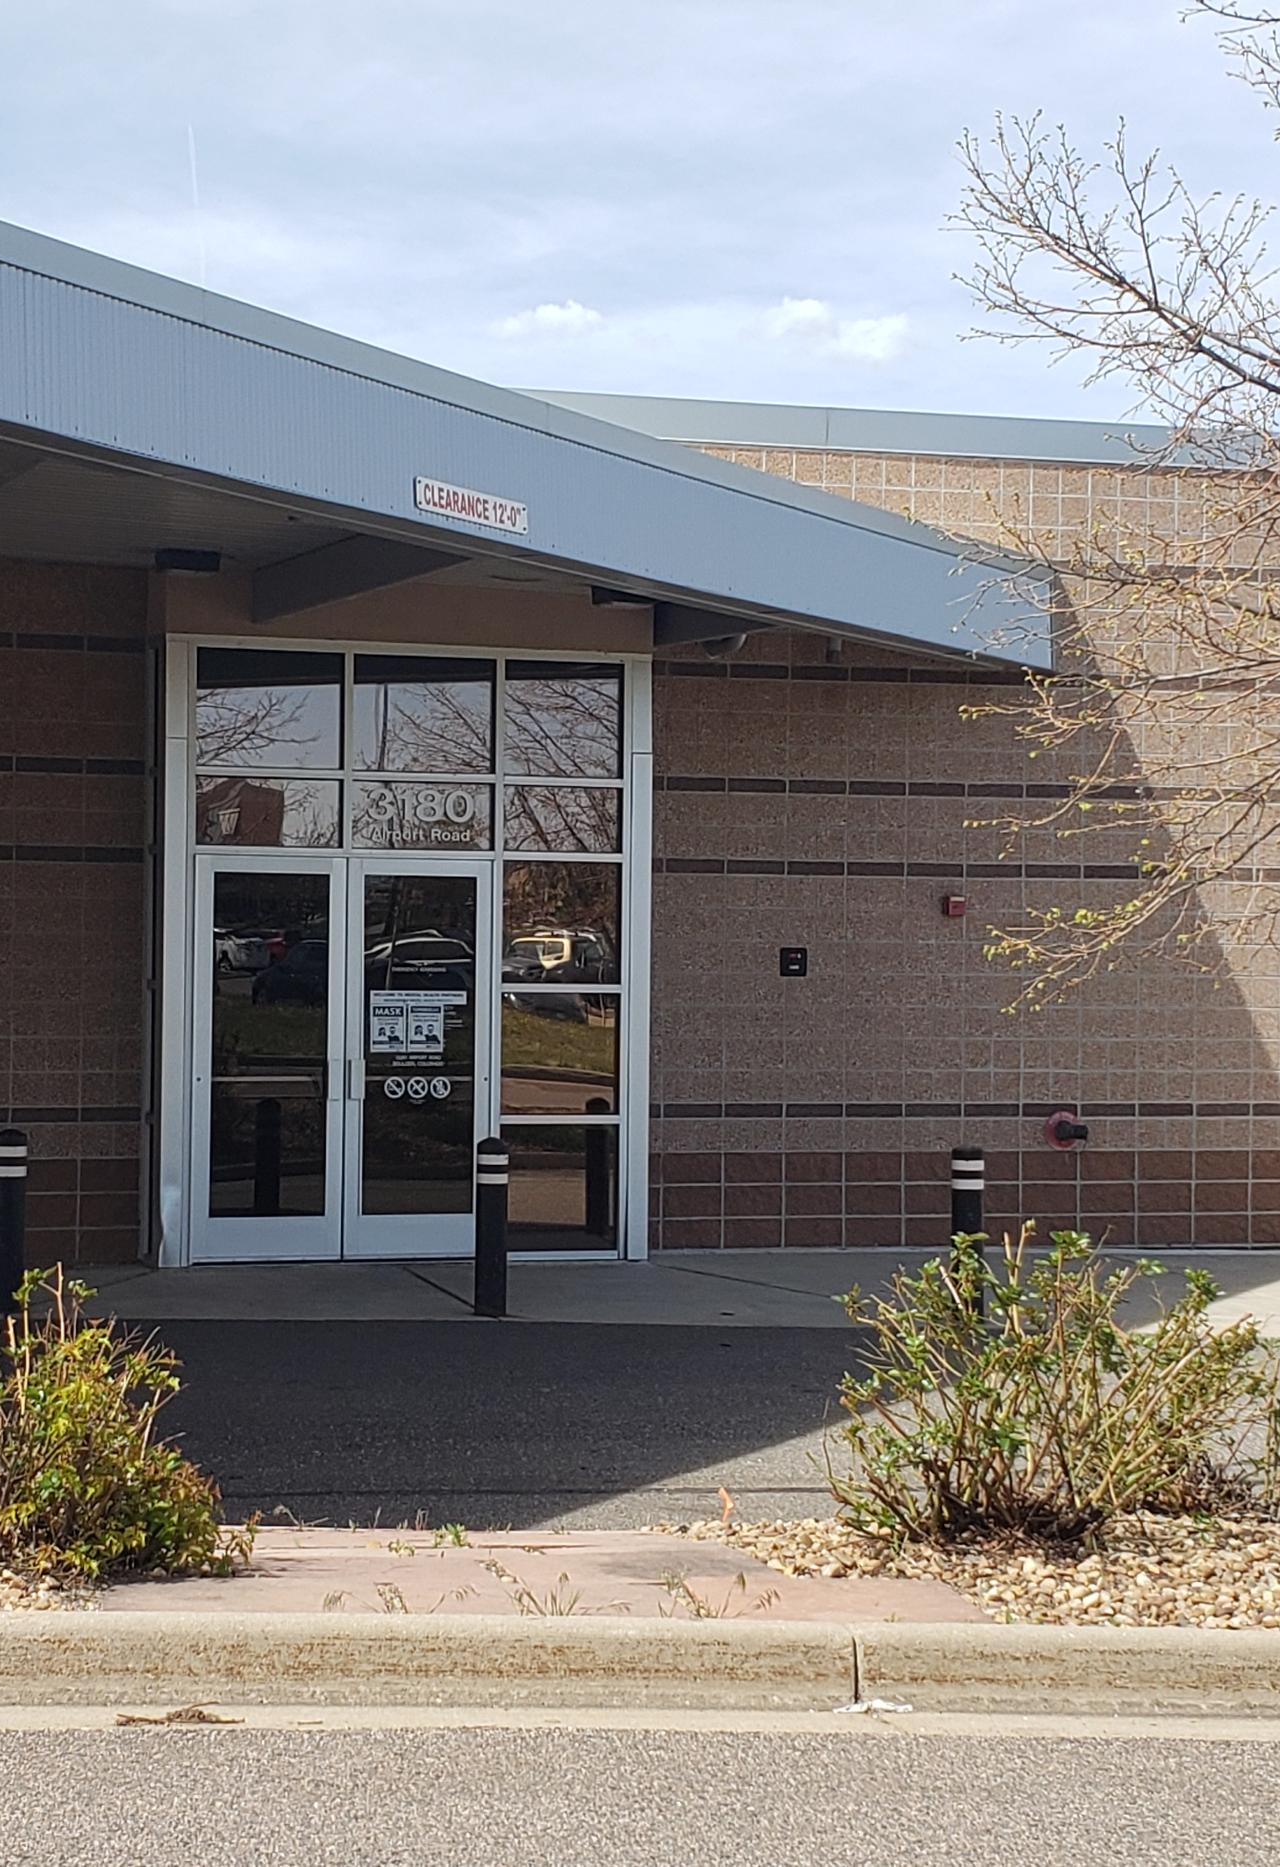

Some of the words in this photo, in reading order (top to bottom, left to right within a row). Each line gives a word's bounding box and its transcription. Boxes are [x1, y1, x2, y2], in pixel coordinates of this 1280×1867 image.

[423, 483, 489, 521] CLEARANCE
[367, 788, 474, 824] 3180
[372, 828, 424, 843] Airport
[431, 829, 470, 842] Road
[375, 1007, 401, 1016] MASK
